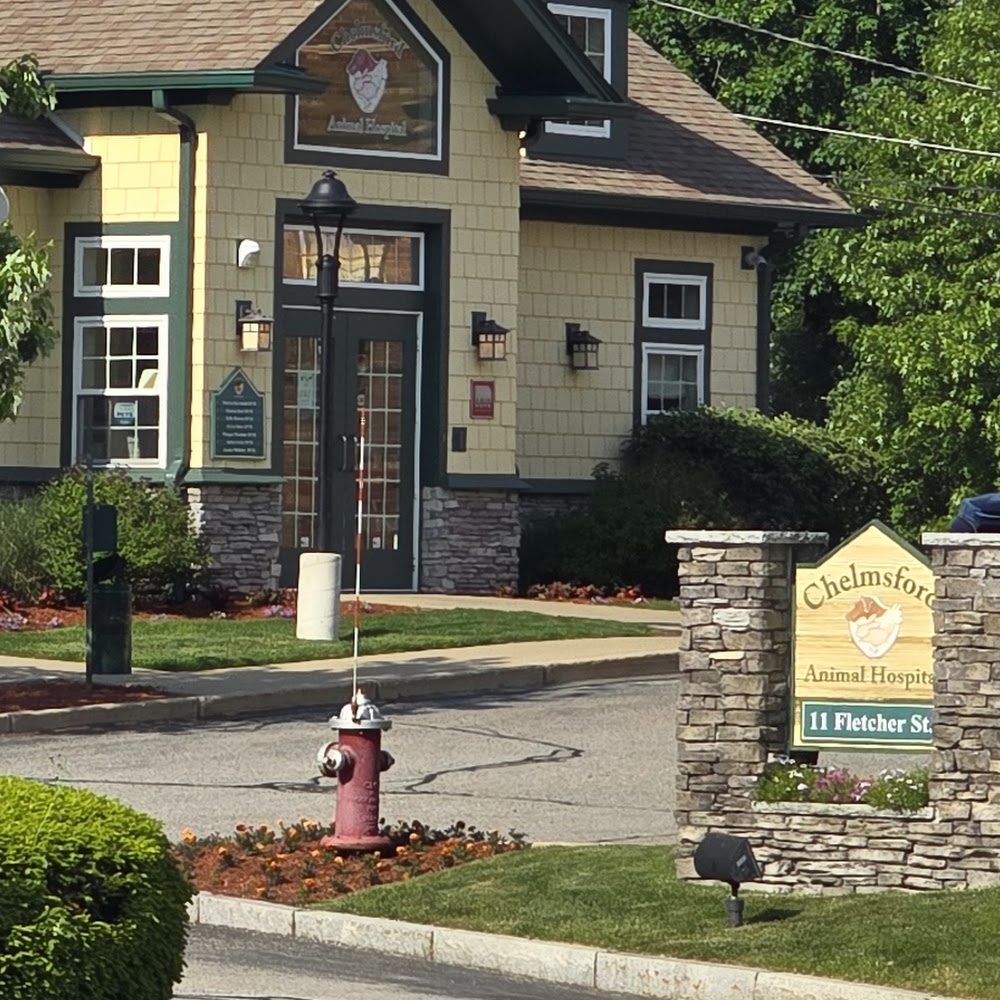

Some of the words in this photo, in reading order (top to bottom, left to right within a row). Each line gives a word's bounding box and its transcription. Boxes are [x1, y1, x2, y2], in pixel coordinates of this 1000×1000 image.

[327, 114, 363, 133] Animal
[364, 117, 407, 140] Hospital
[804, 664, 865, 683] Animal
[871, 665, 935, 691] Hospita
[809, 711, 828, 731] 11
[834, 711, 907, 733] Fletcher
